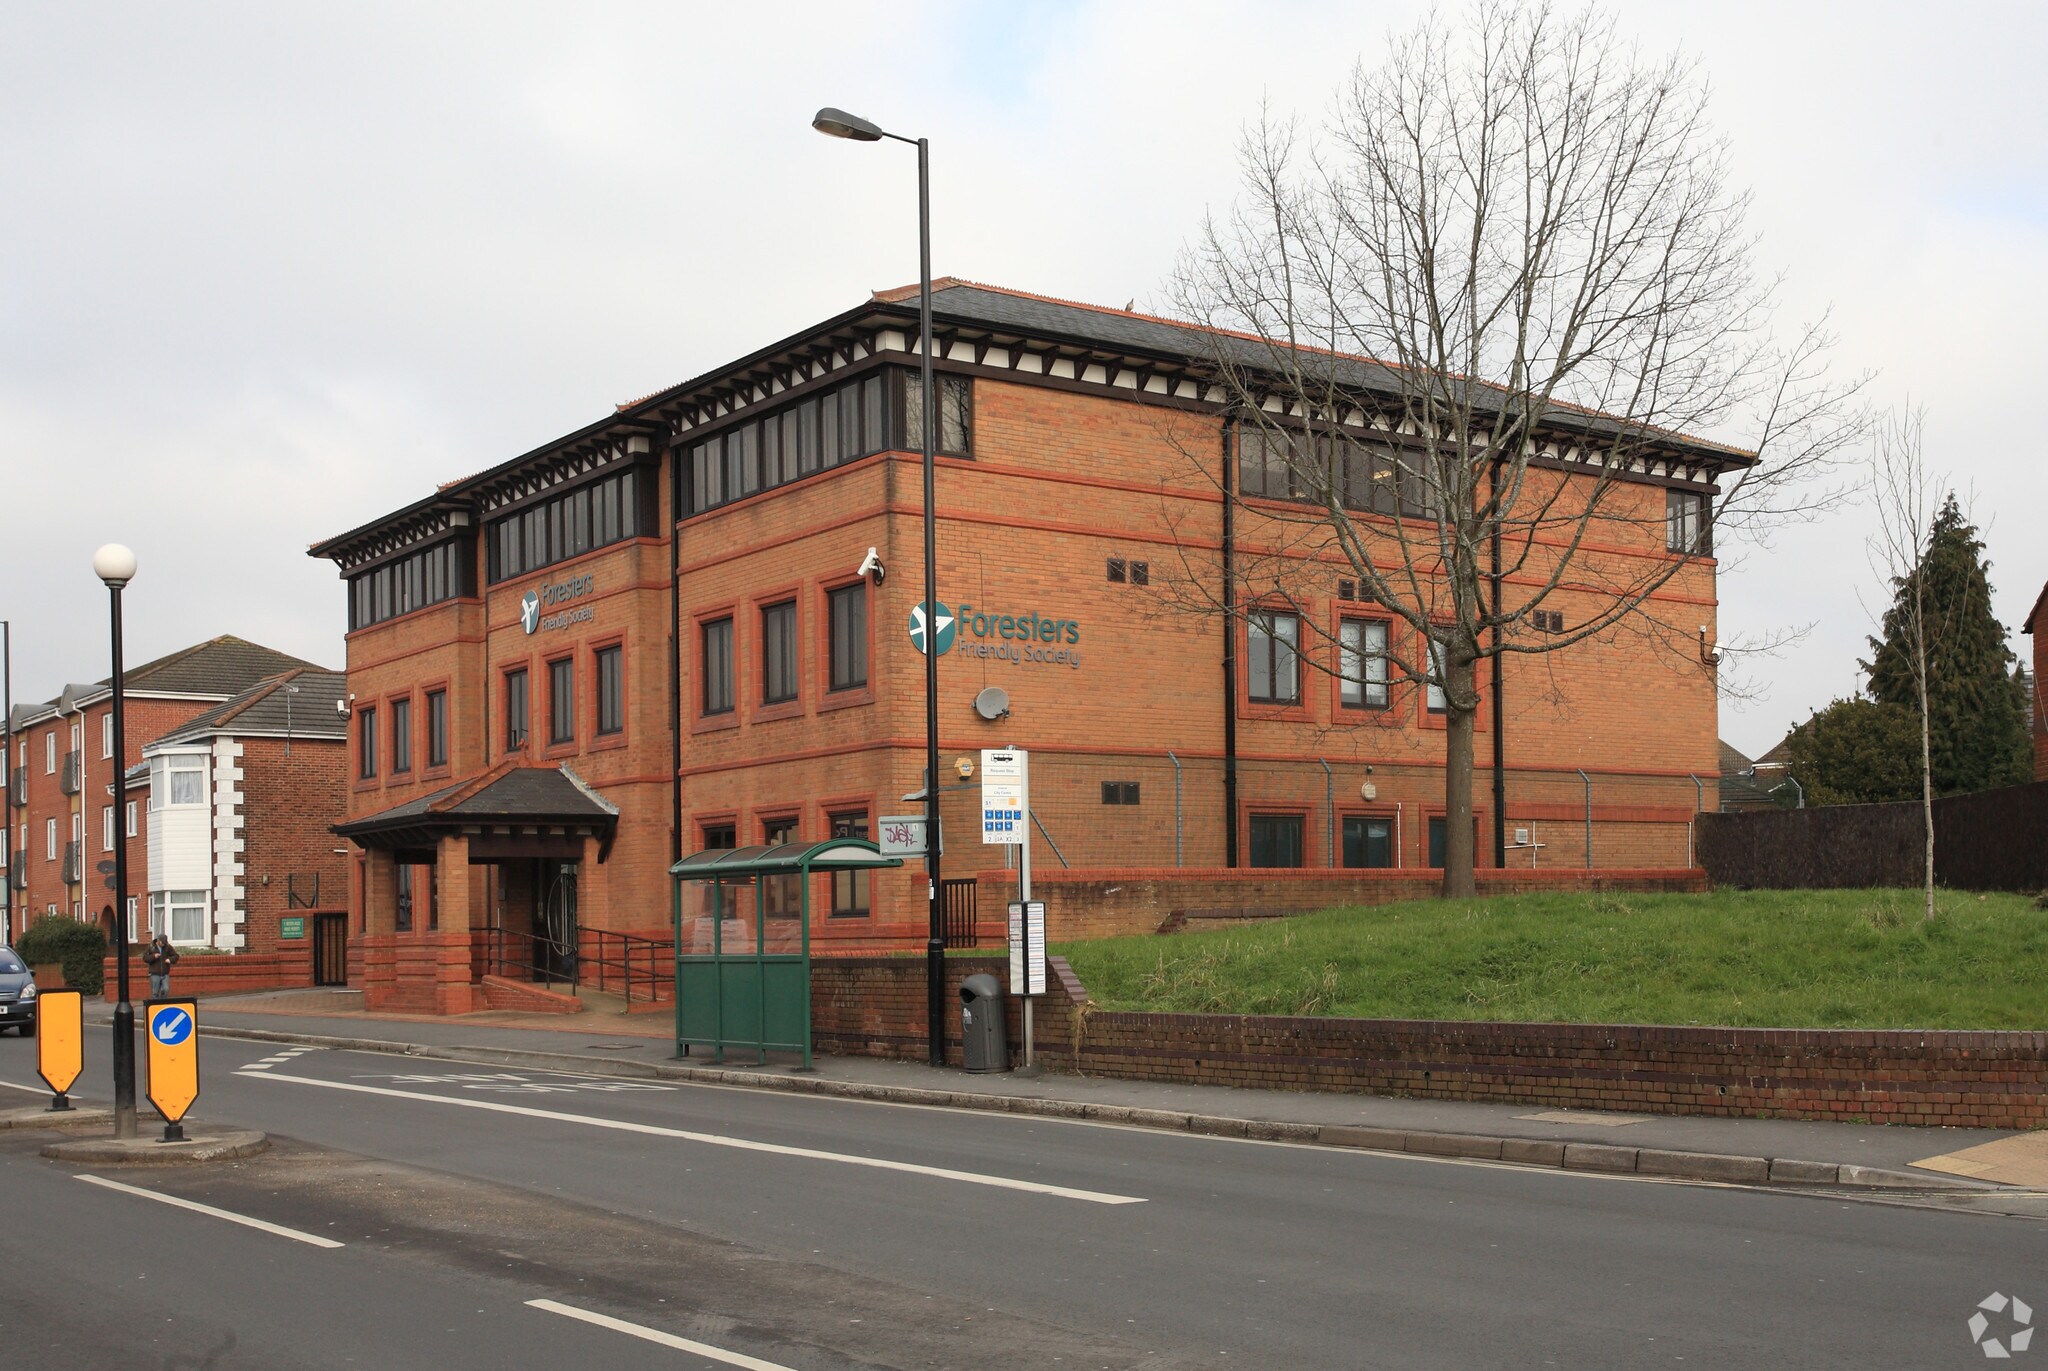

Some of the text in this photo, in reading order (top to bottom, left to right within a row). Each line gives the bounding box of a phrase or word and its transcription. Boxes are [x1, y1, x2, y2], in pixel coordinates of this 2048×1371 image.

[541, 573, 594, 609] Foresters
[541, 606, 595, 632] Friendly Society
[958, 604, 1080, 645] Foresters
[958, 638, 1081, 670] Friendly Society
[462, 1082, 680, 1093] BUS
